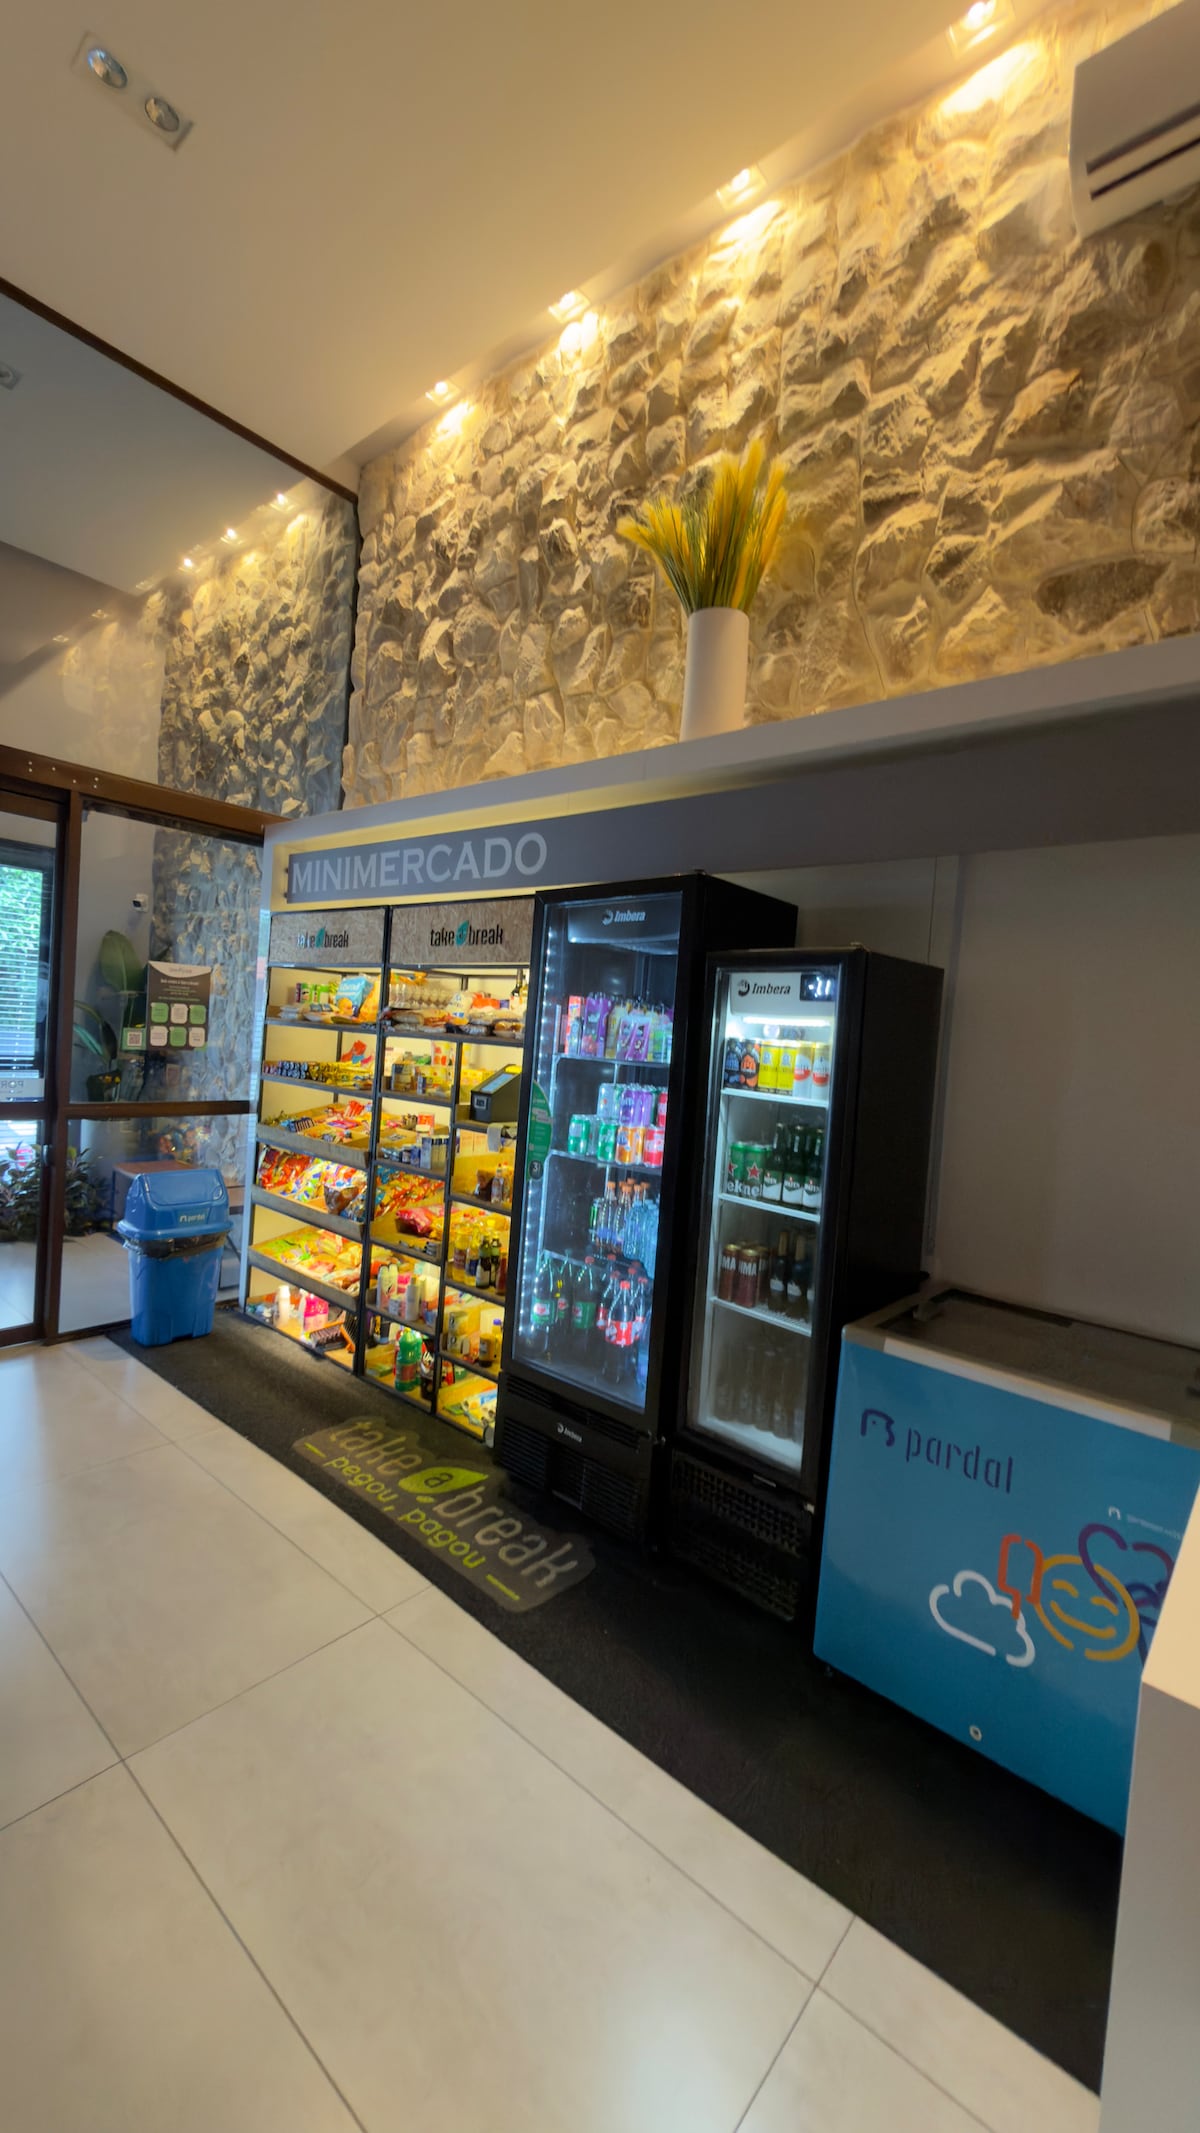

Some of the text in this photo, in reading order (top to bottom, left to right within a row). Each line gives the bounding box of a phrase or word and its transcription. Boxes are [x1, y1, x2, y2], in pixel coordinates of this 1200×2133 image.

[291, 832, 548, 895] MINIMERCADO
[430, 927, 455, 946] take
[469, 924, 504, 945] break
[614, 910, 646, 922] Imbera
[324, 929, 349, 948] break
[752, 983, 791, 995] Imbera
[905, 1427, 1013, 1494] pardal
[323, 1456, 486, 1569] pegou, pagou
[330, 1421, 578, 1588] take a break
